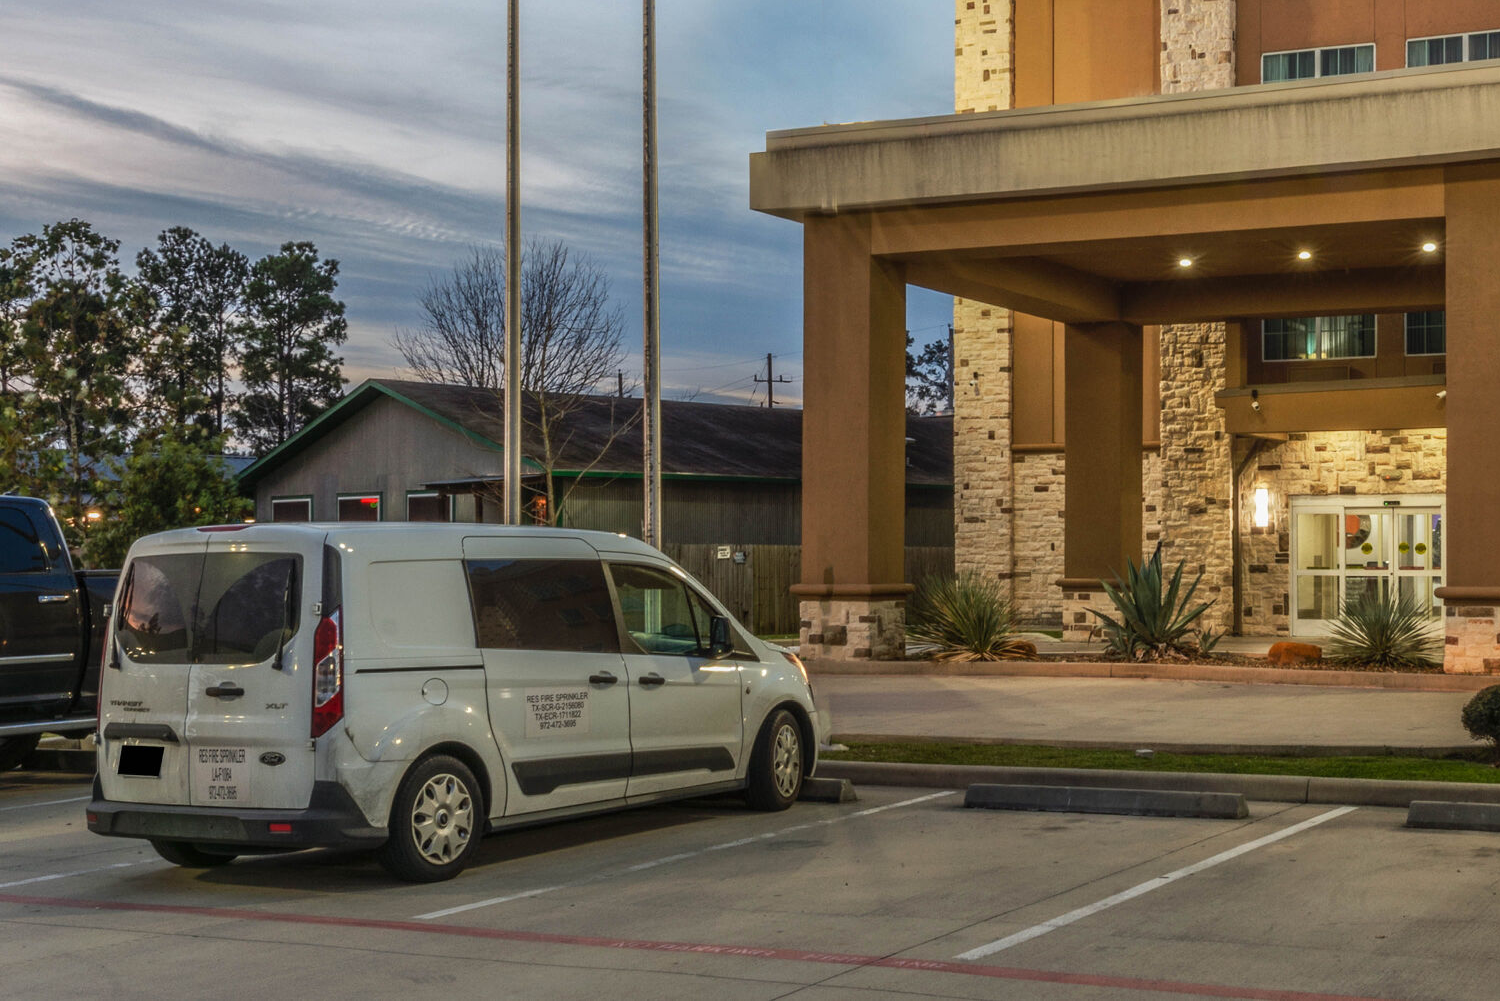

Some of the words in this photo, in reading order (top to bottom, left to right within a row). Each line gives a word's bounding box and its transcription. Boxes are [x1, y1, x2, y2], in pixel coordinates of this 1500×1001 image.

[527, 695, 540, 704] RES
[541, 694, 554, 703] FIRE
[556, 692, 588, 701] SPRINKLER
[199, 749, 208, 763] RES
[209, 749, 219, 763] FIRE
[220, 749, 245, 763] SPRINKLER
